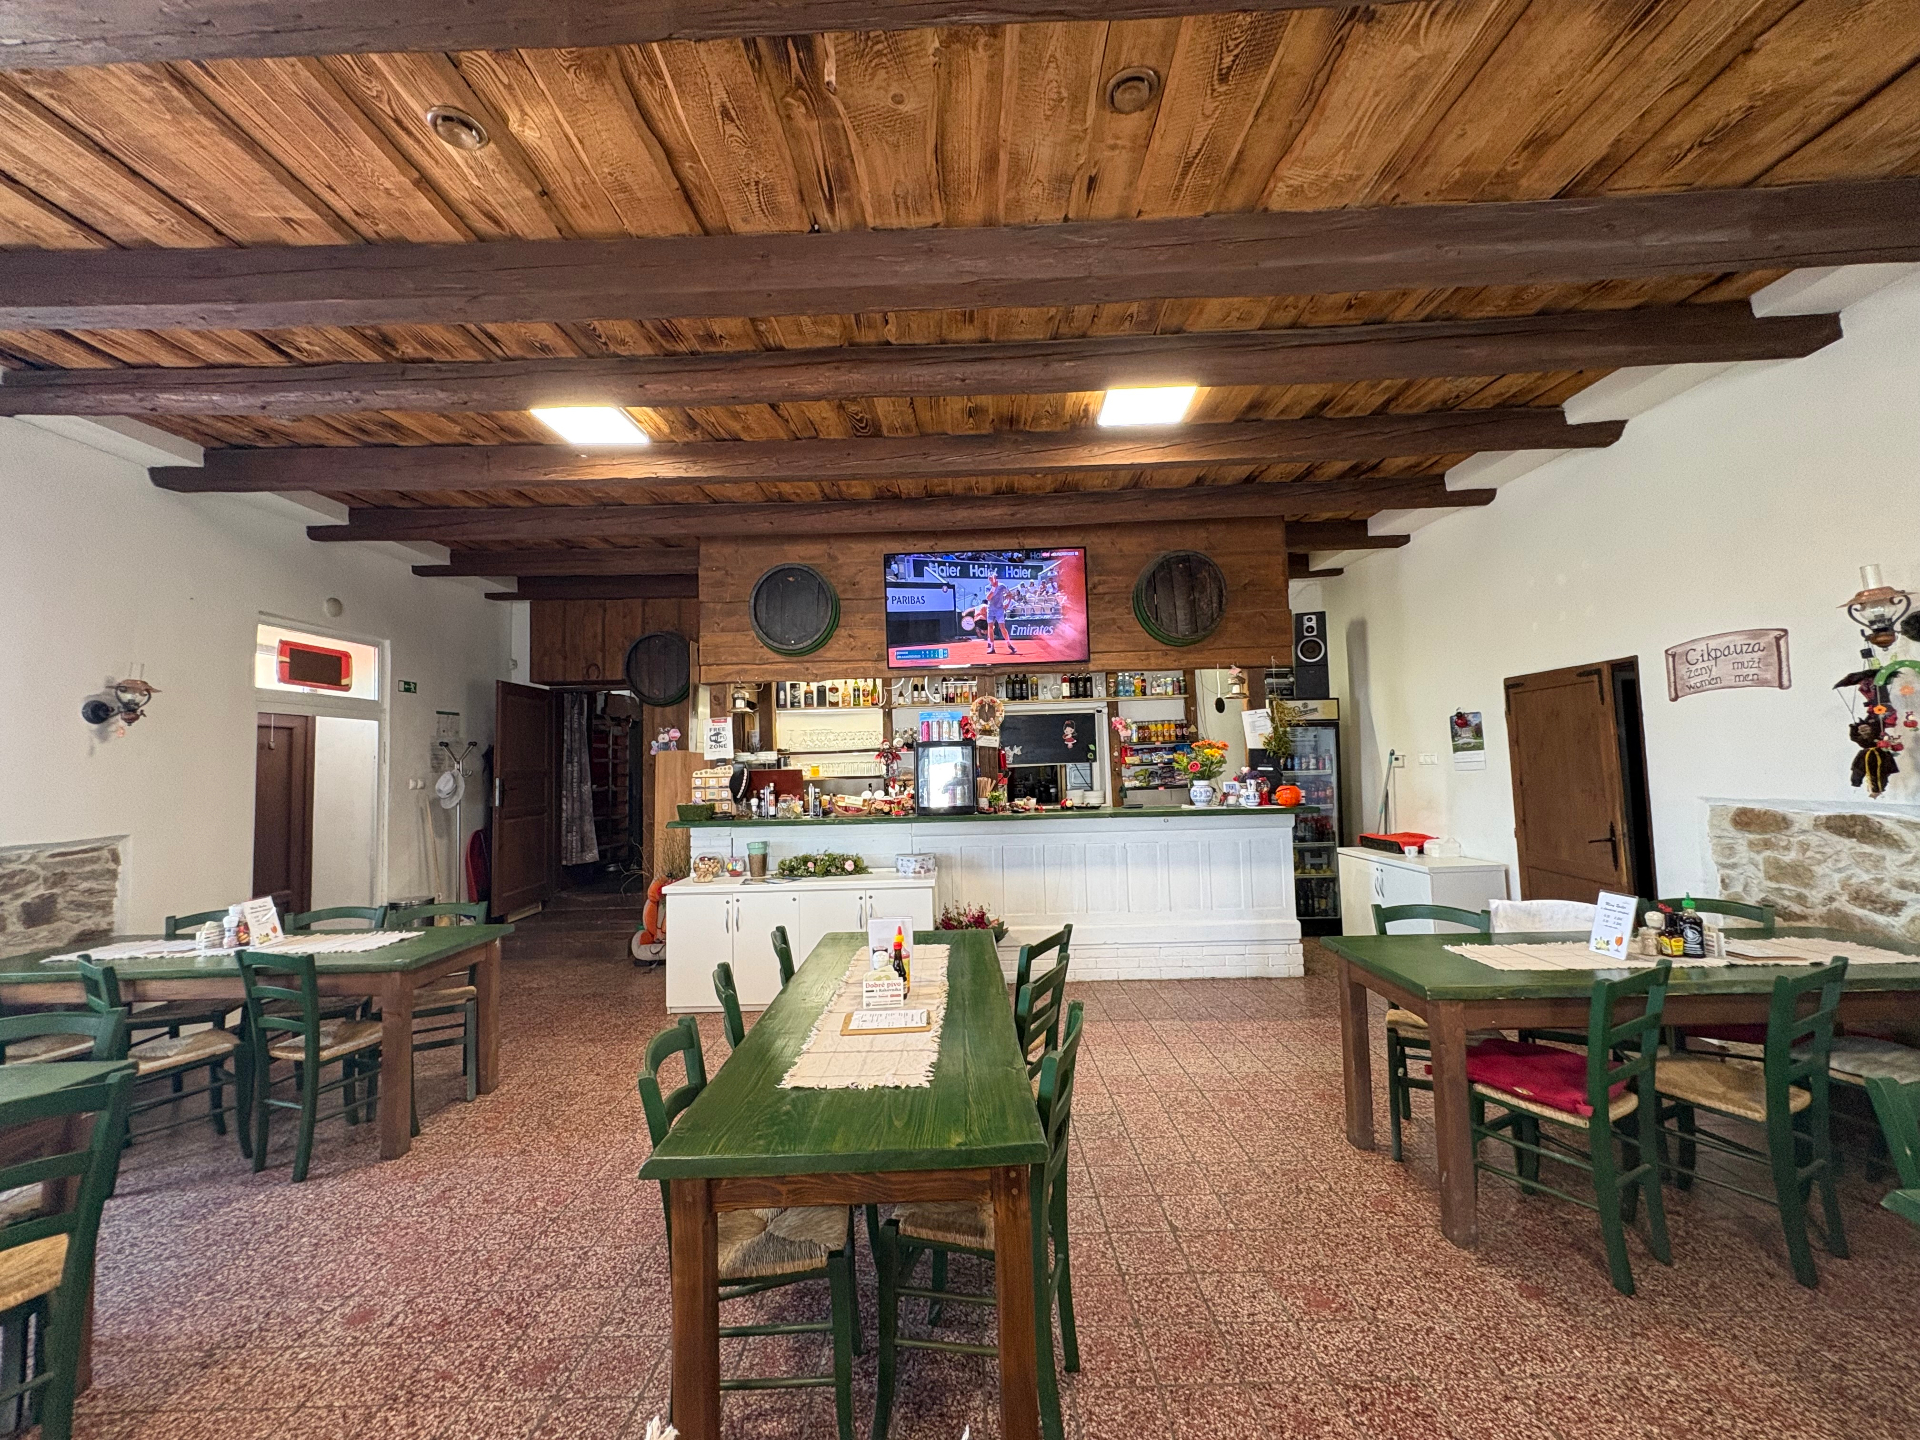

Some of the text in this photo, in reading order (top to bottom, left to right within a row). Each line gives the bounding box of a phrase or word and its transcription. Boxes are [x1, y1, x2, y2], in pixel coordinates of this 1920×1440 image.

[929, 562, 1032, 579] Haier Hair Haier
[891, 595, 926, 605] PARIBAS
[1010, 624, 1054, 636] Emirates
[1686, 642, 1765, 667] Cikpauza
[1685, 664, 1714, 680] ženy
[1734, 673, 1760, 683] men
[1685, 676, 1723, 691] women
